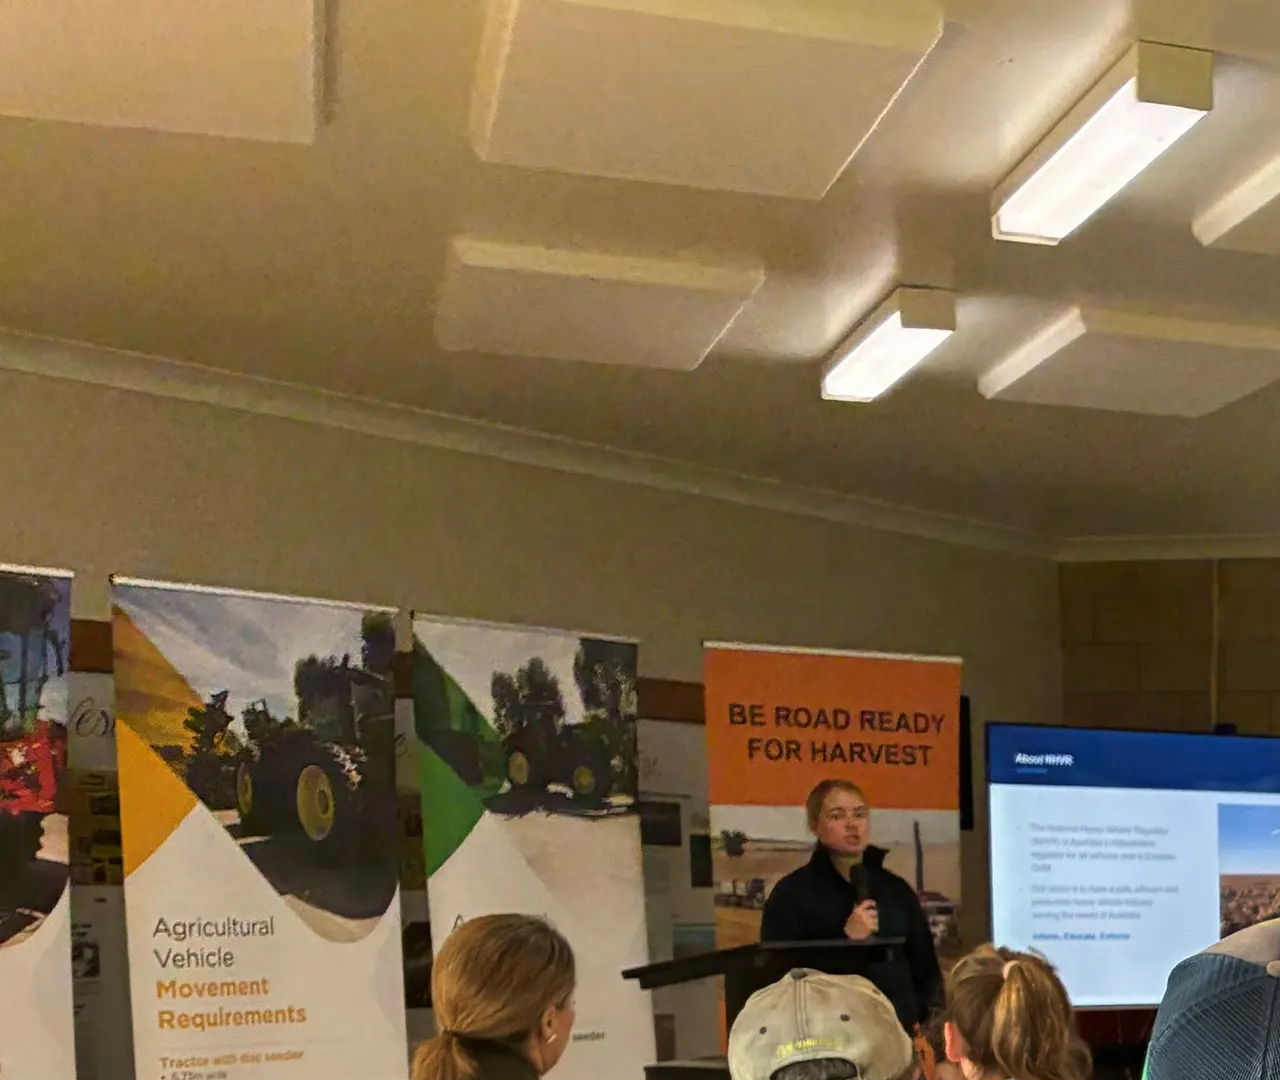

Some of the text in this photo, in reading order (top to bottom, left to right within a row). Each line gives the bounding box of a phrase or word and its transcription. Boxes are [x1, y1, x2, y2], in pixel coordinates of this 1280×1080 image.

[728, 703, 946, 735] BE ROAD READY
[747, 738, 934, 766] FOR HARVEST
[152, 915, 275, 942] Agricultural
[153, 946, 235, 969] Vehicle
[156, 977, 270, 999] Movement
[158, 1004, 308, 1033] Requirements
[158, 1055, 210, 1069] Tractor
